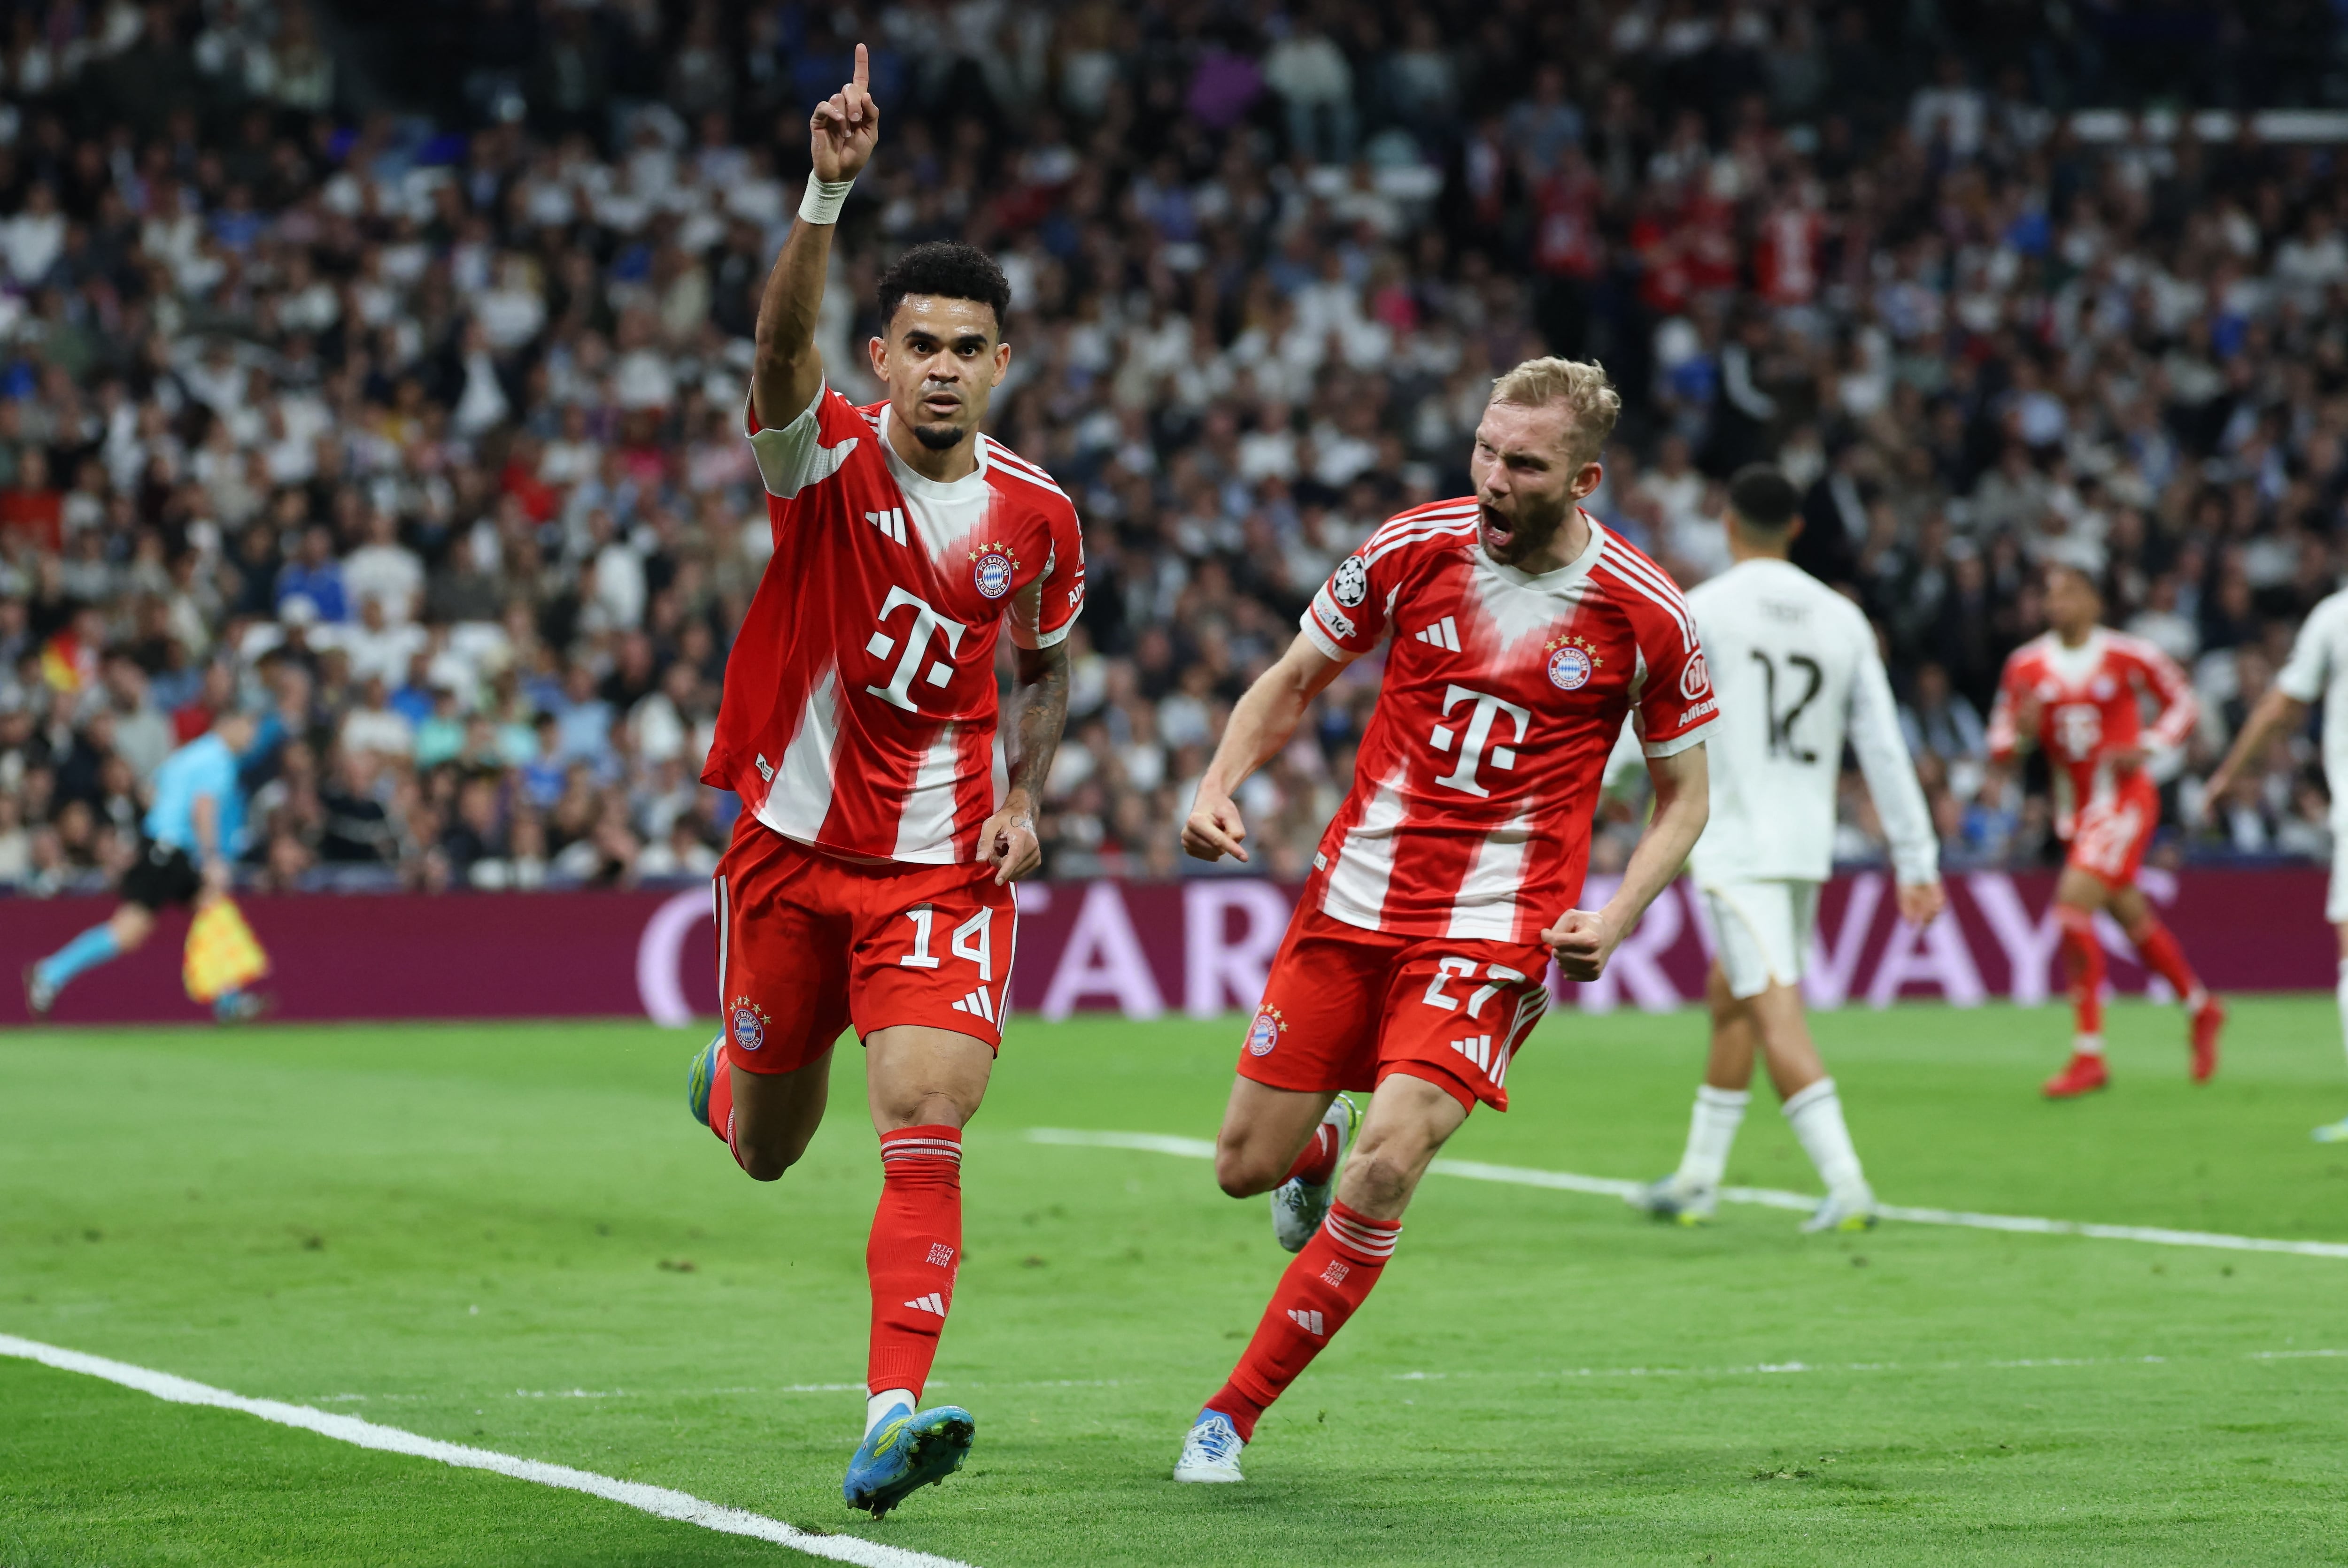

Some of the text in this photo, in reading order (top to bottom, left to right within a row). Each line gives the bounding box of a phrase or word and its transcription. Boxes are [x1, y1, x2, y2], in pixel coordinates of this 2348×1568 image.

[978, 558, 1009, 576] FC BAYERN
[865, 584, 967, 713] T
[1751, 649, 1823, 763] 12
[1429, 684, 1531, 798] T
[899, 902, 993, 982] 14
[1421, 956, 1526, 1020] 27
[740, 1011, 760, 1030] BAYERN
[929, 1249, 950, 1261] SAN
[931, 1242, 954, 1255] MIA
[926, 1255, 948, 1268] MIA
[1329, 1260, 1350, 1275] MIA
[1319, 1272, 1340, 1288] MIA
